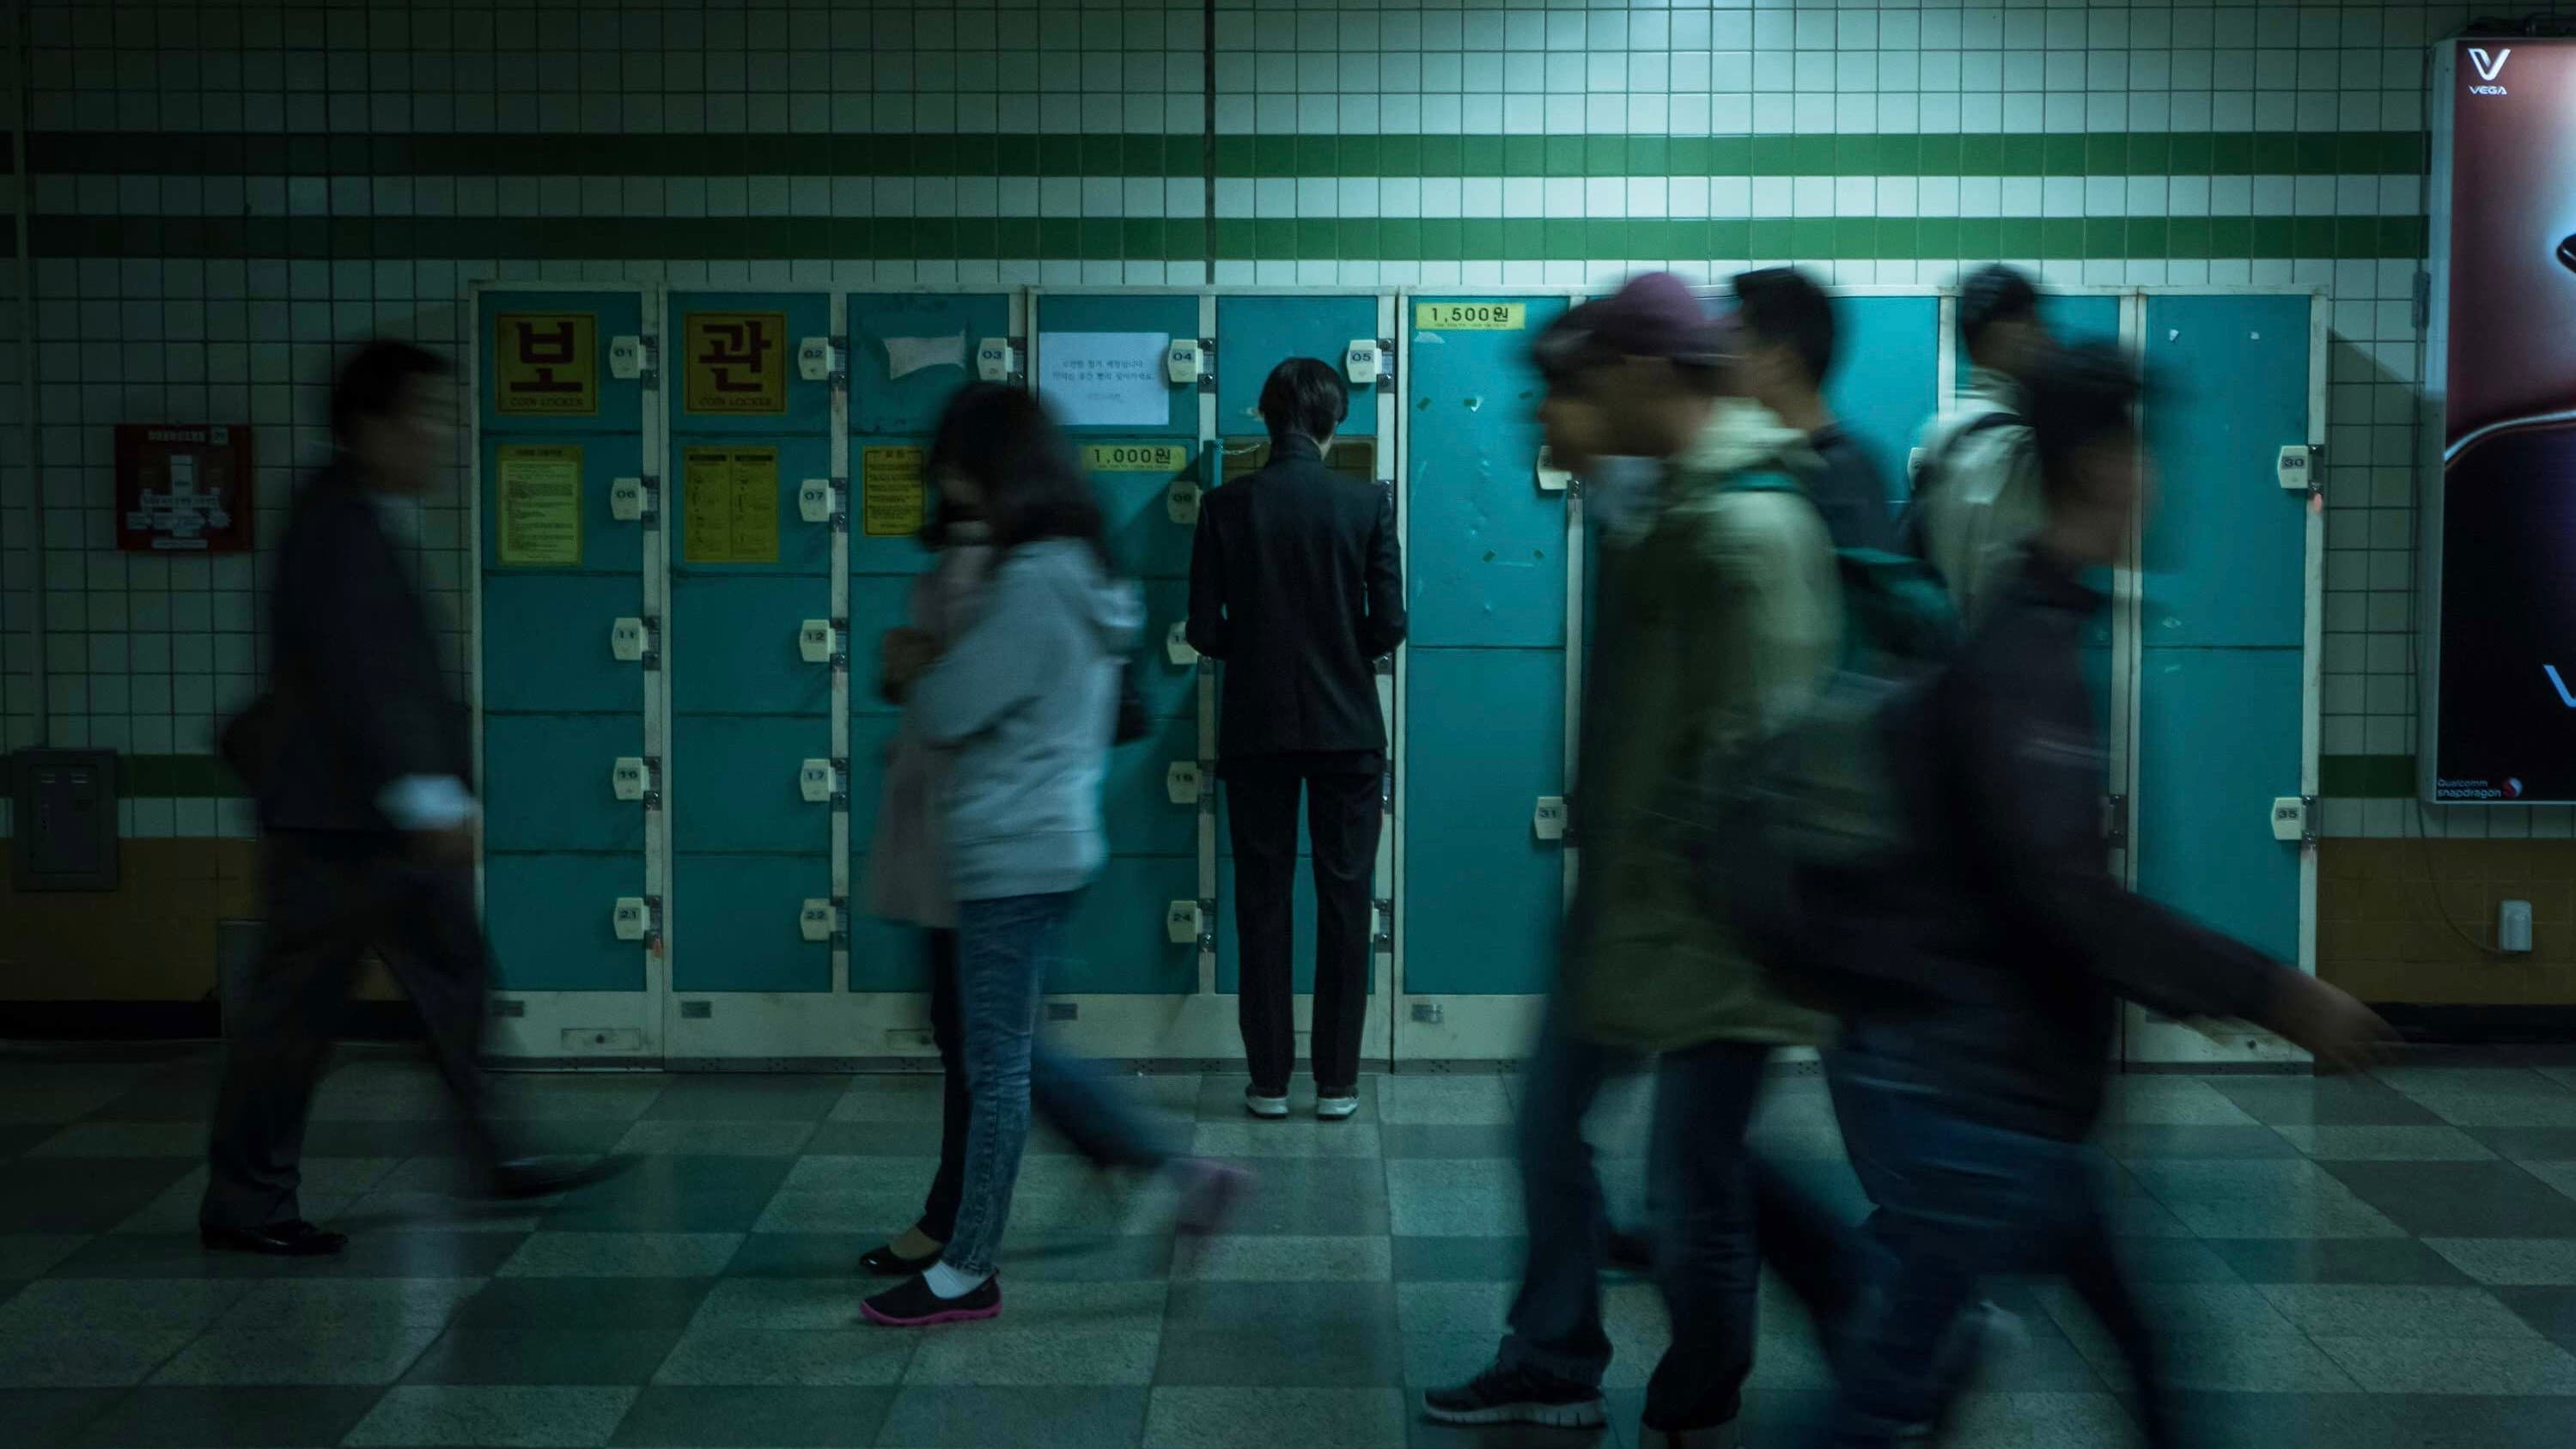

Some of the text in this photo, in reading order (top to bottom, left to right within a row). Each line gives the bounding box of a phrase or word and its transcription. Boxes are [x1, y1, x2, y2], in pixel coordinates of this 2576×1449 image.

[2468, 86, 2507, 94] VEGA
[1432, 307, 1508, 323] 1,500원
[510, 321, 582, 393] 보
[614, 348, 633, 358] 01
[698, 320, 772, 393] 관
[804, 349, 822, 359] 02
[983, 350, 1002, 360] 03
[1173, 351, 1192, 361] 04
[1352, 352, 1371, 362] 05
[1093, 447, 1171, 465] 1,000원
[805, 490, 823, 501] 07
[807, 631, 825, 642] 12
[2278, 809, 2298, 819] 35
